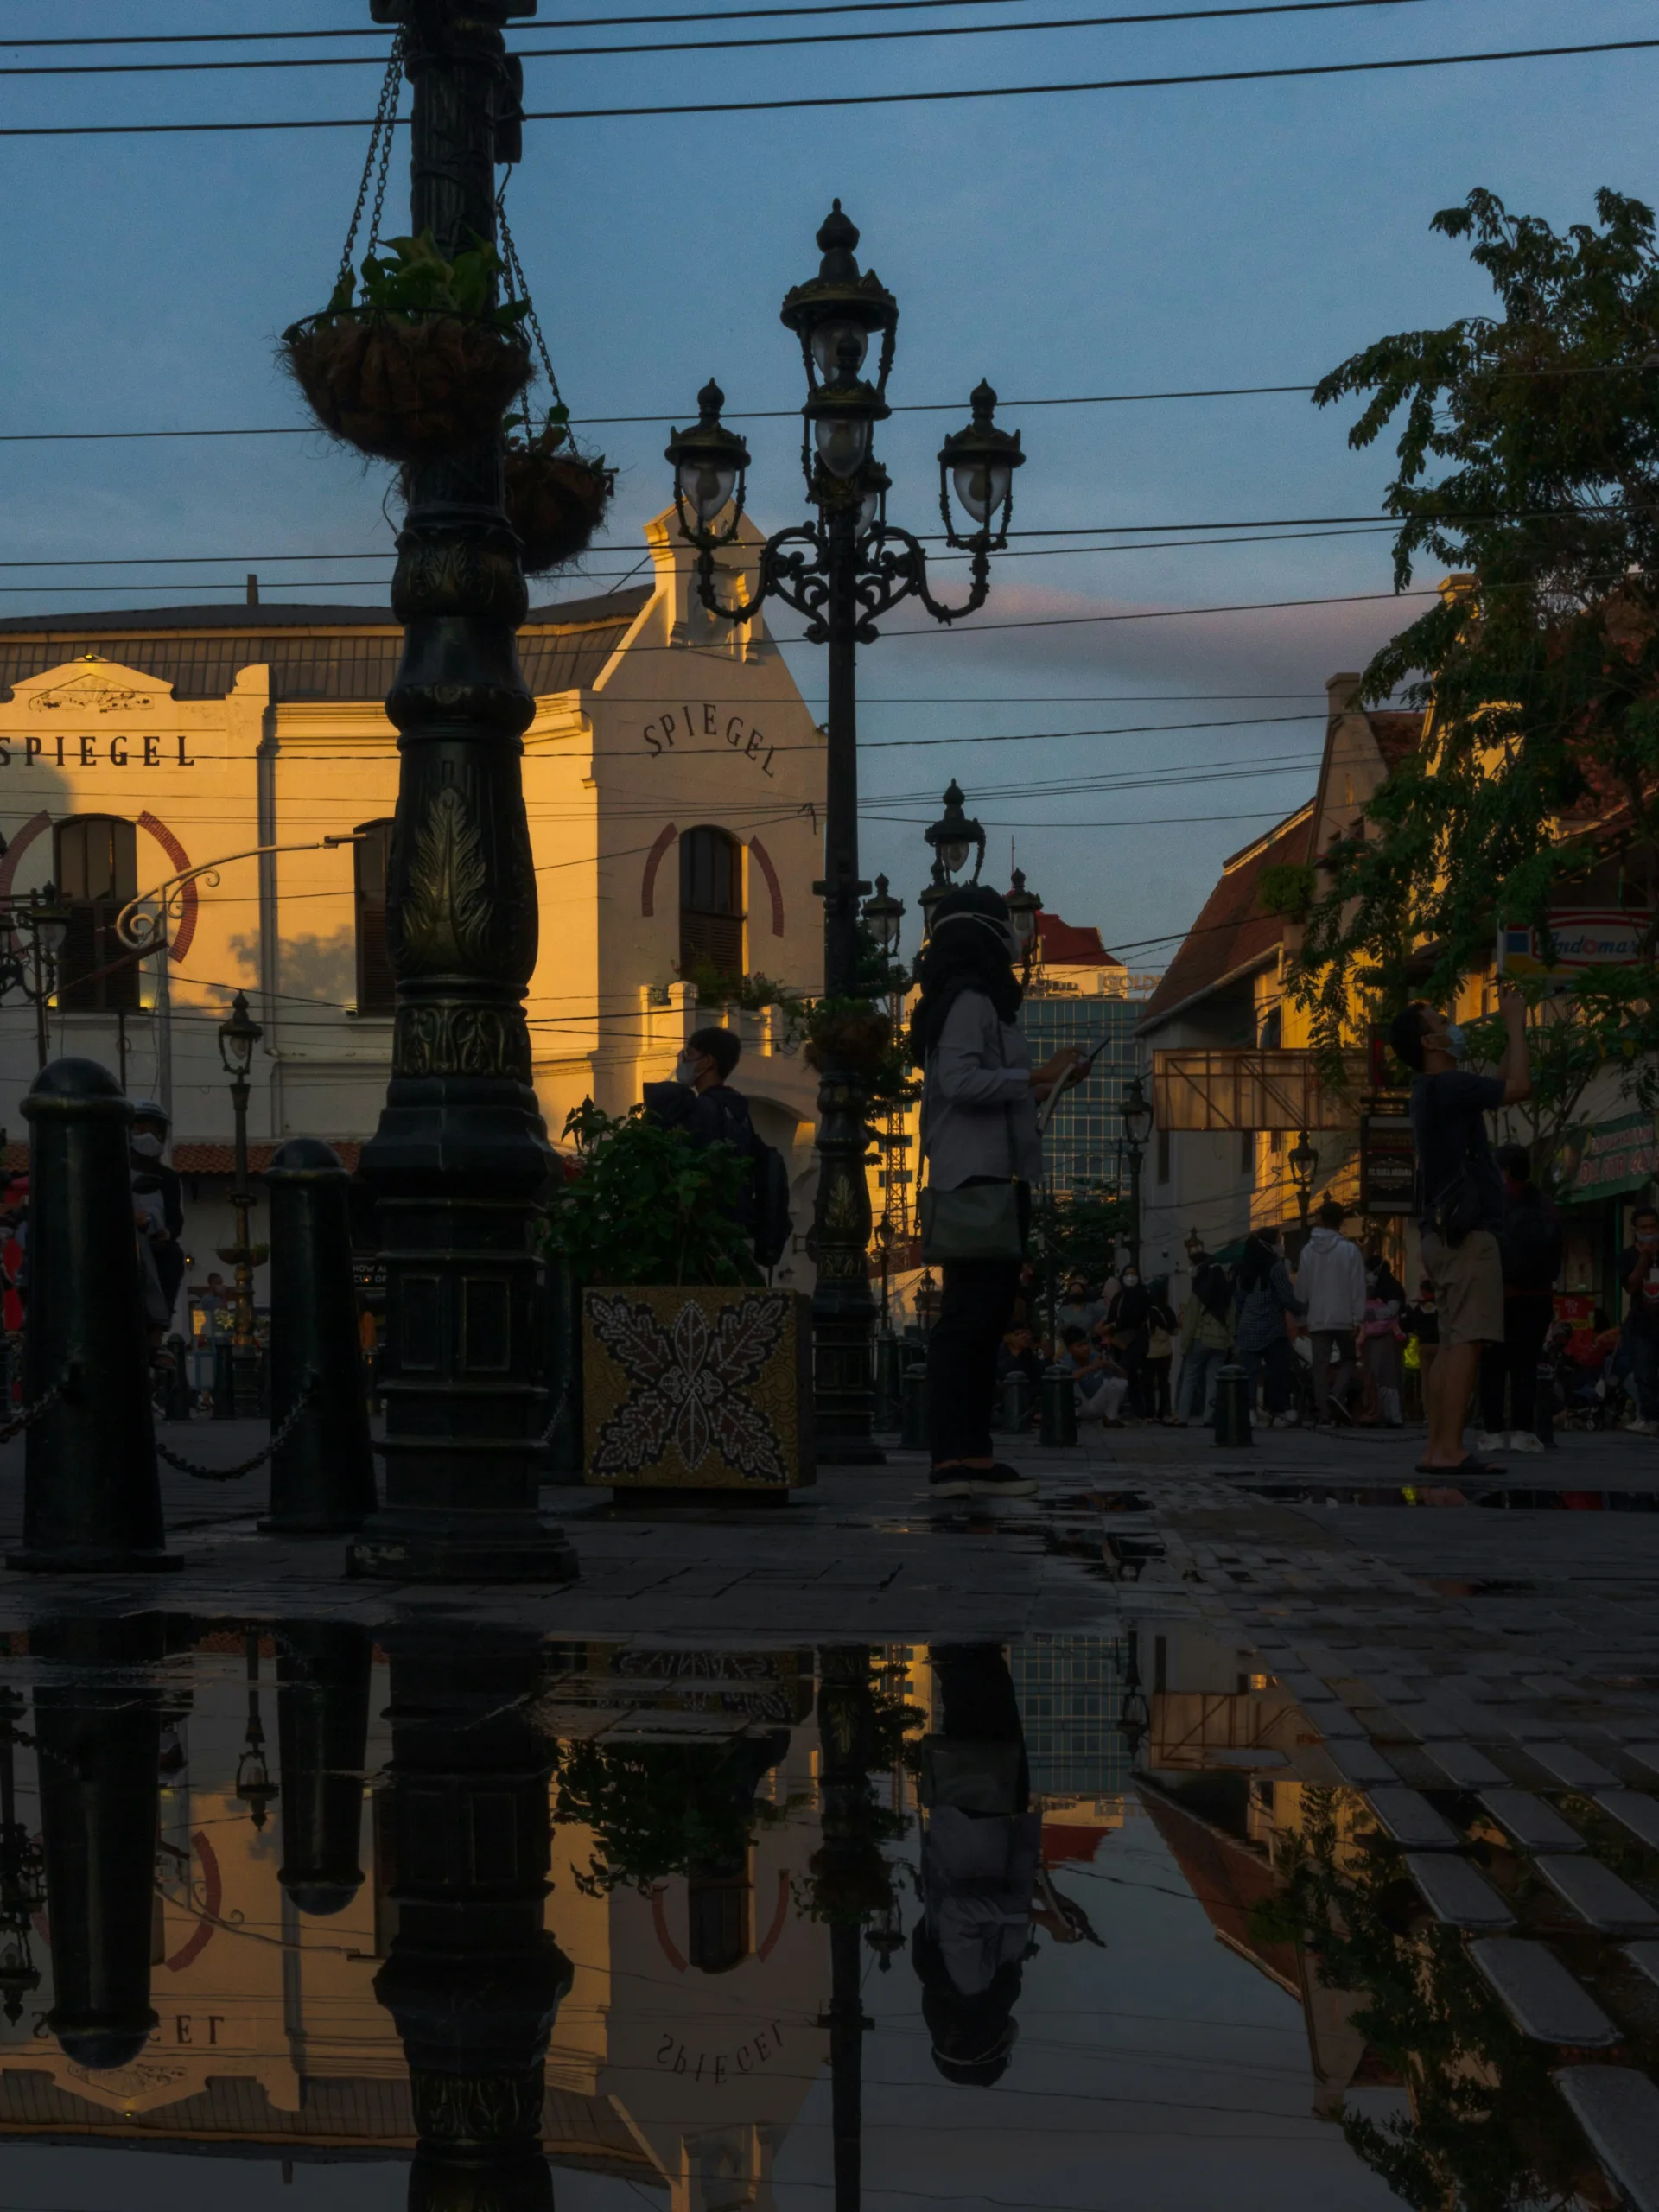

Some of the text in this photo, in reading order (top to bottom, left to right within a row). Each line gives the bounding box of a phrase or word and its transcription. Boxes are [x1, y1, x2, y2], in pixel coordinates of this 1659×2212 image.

[0, 736, 194, 766] SPIEGEL
[643, 703, 774, 778] SPIEGEL
[1549, 931, 1640, 956] Indomar
